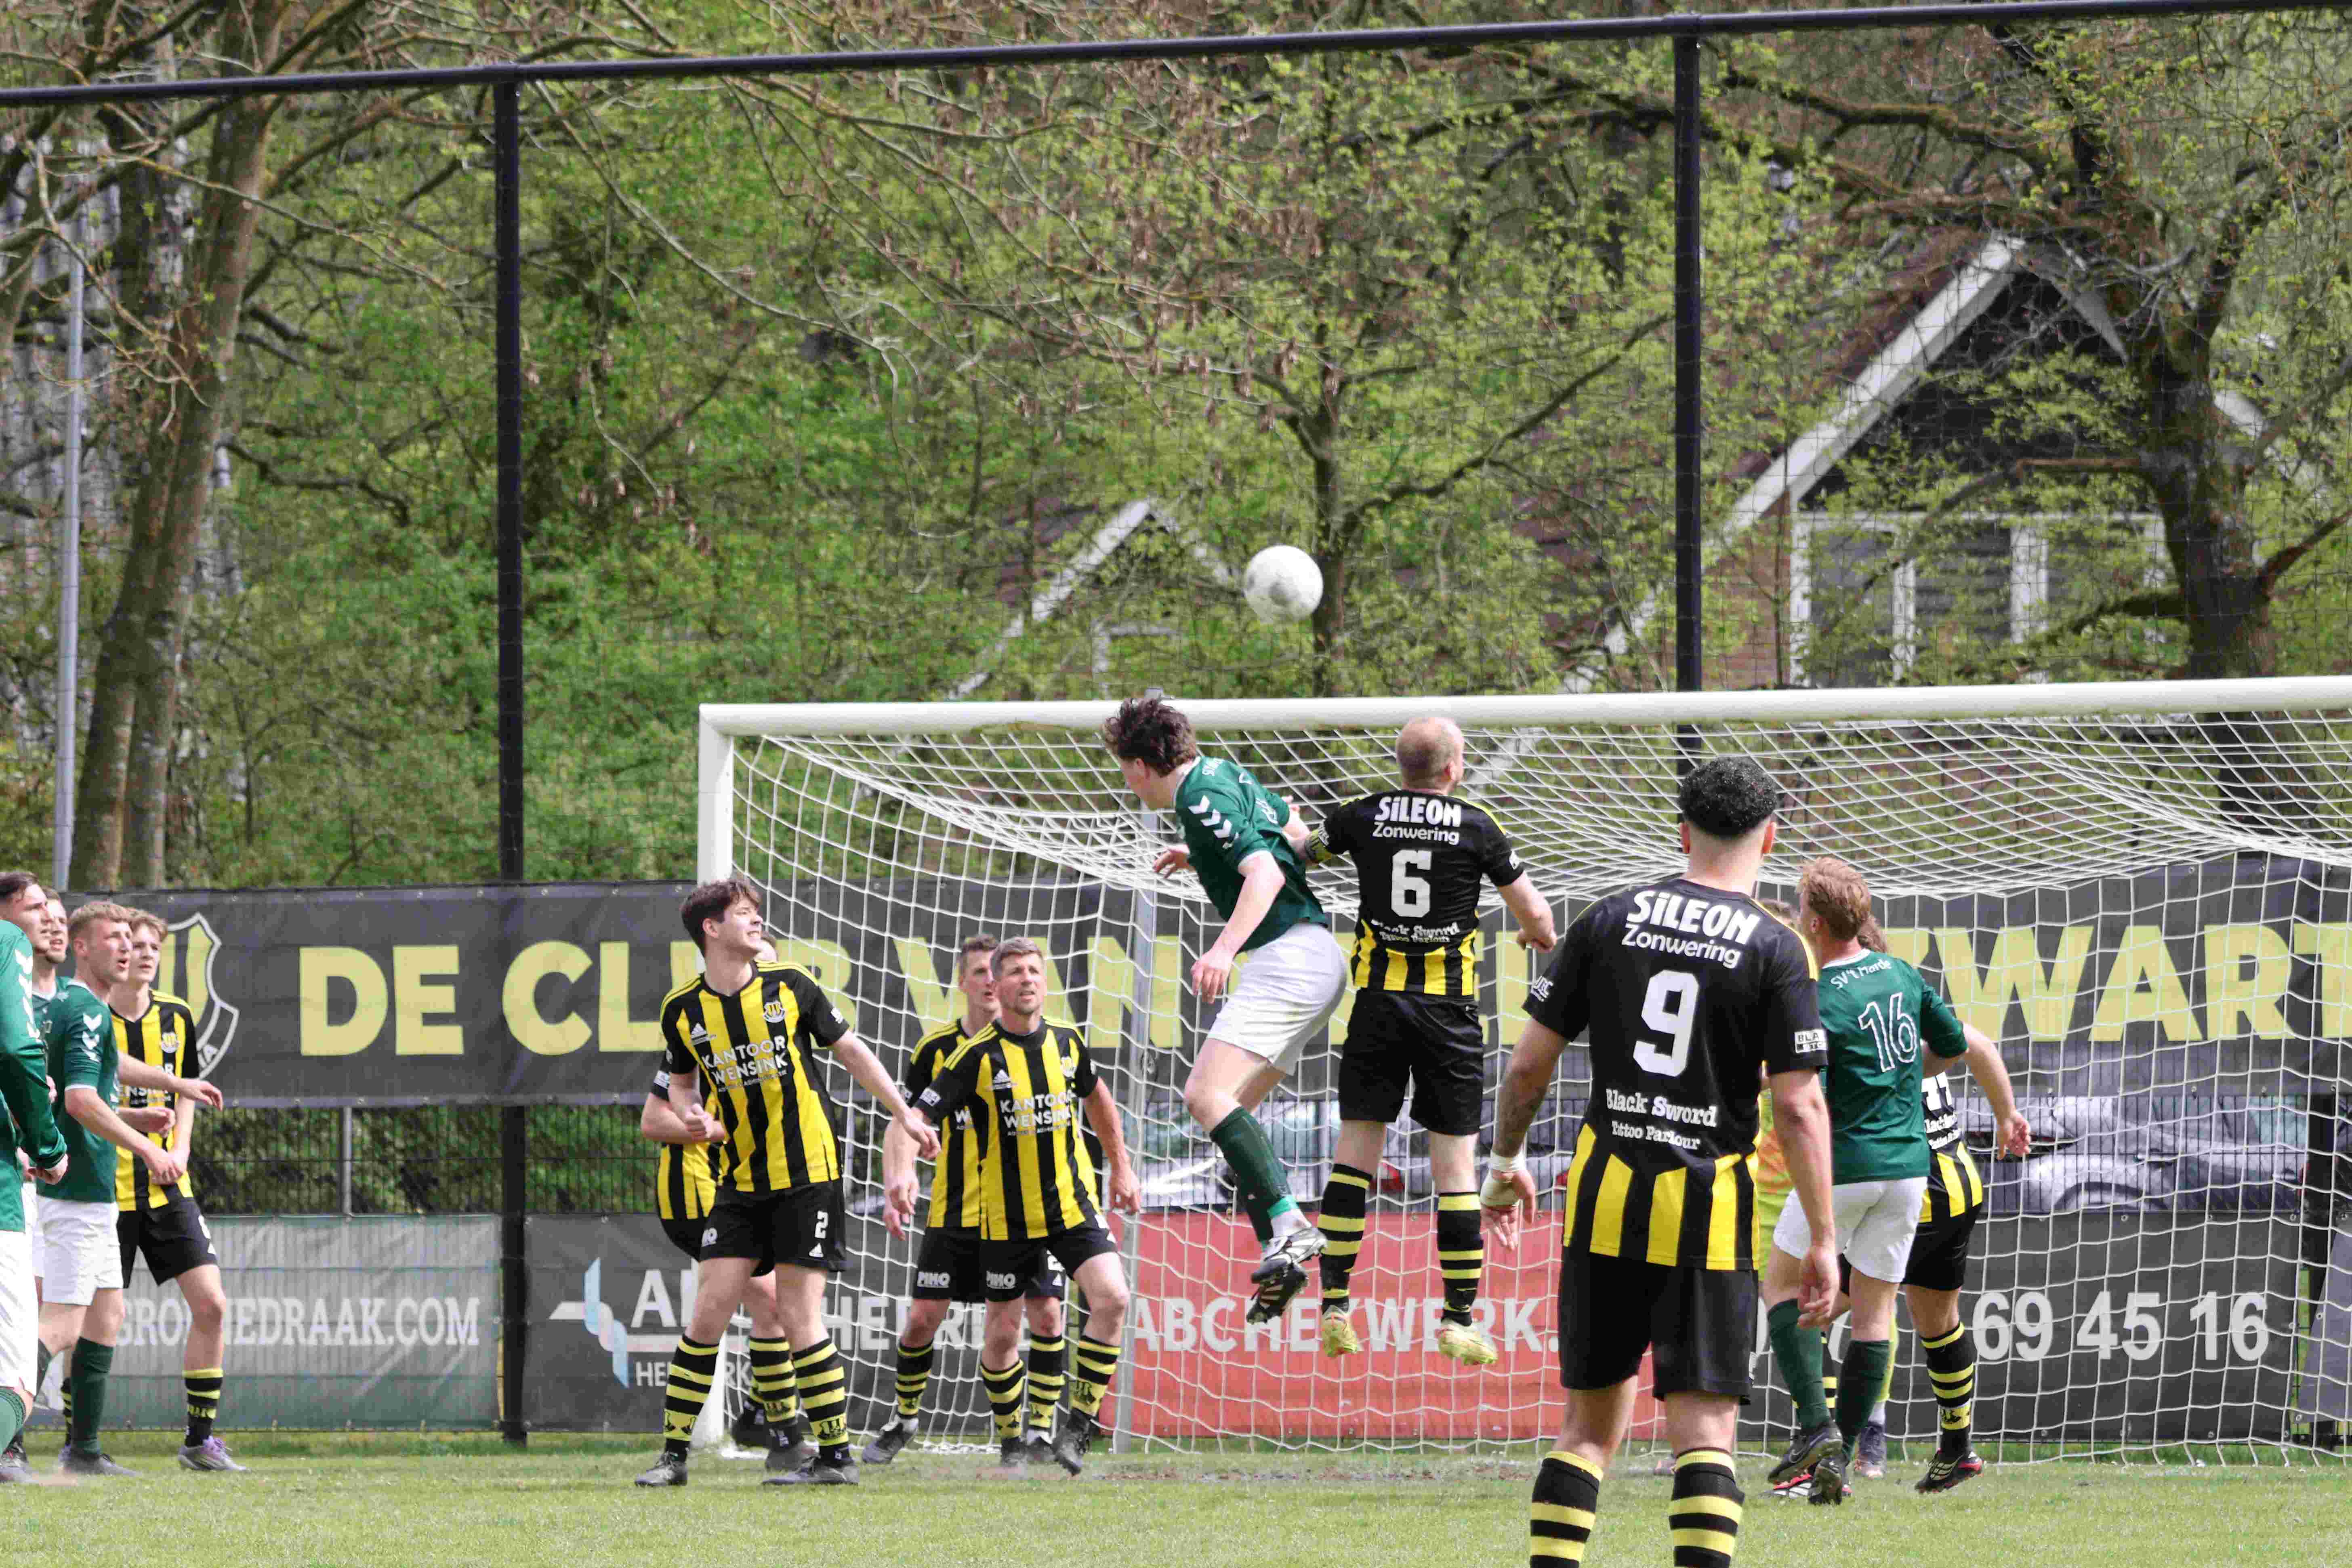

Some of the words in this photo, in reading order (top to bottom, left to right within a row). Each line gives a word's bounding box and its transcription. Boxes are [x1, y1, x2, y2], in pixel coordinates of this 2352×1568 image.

[1373, 822, 1460, 845] Zonwering
[1391, 849, 1432, 918] 6
[1621, 923, 1741, 969] Zonwering
[299, 945, 464, 1055] DE
[502, 940, 856, 1055] CLB
[1633, 969, 1699, 1077] 9
[1858, 992, 1917, 1073] 16
[702, 1035, 786, 1069] KANTOOR
[711, 1052, 788, 1084] WENSINK
[1606, 1088, 1648, 1114] Black
[1651, 1096, 1717, 1128] Sword
[1645, 1125, 1701, 1150] Parlour
[815, 1210, 828, 1239] 2
[115, 1296, 480, 1347] GROEDRAAK.COM
[1972, 1291, 2053, 1361] 69
[2077, 1291, 2161, 1360] 45
[2190, 1291, 2269, 1361] 16
